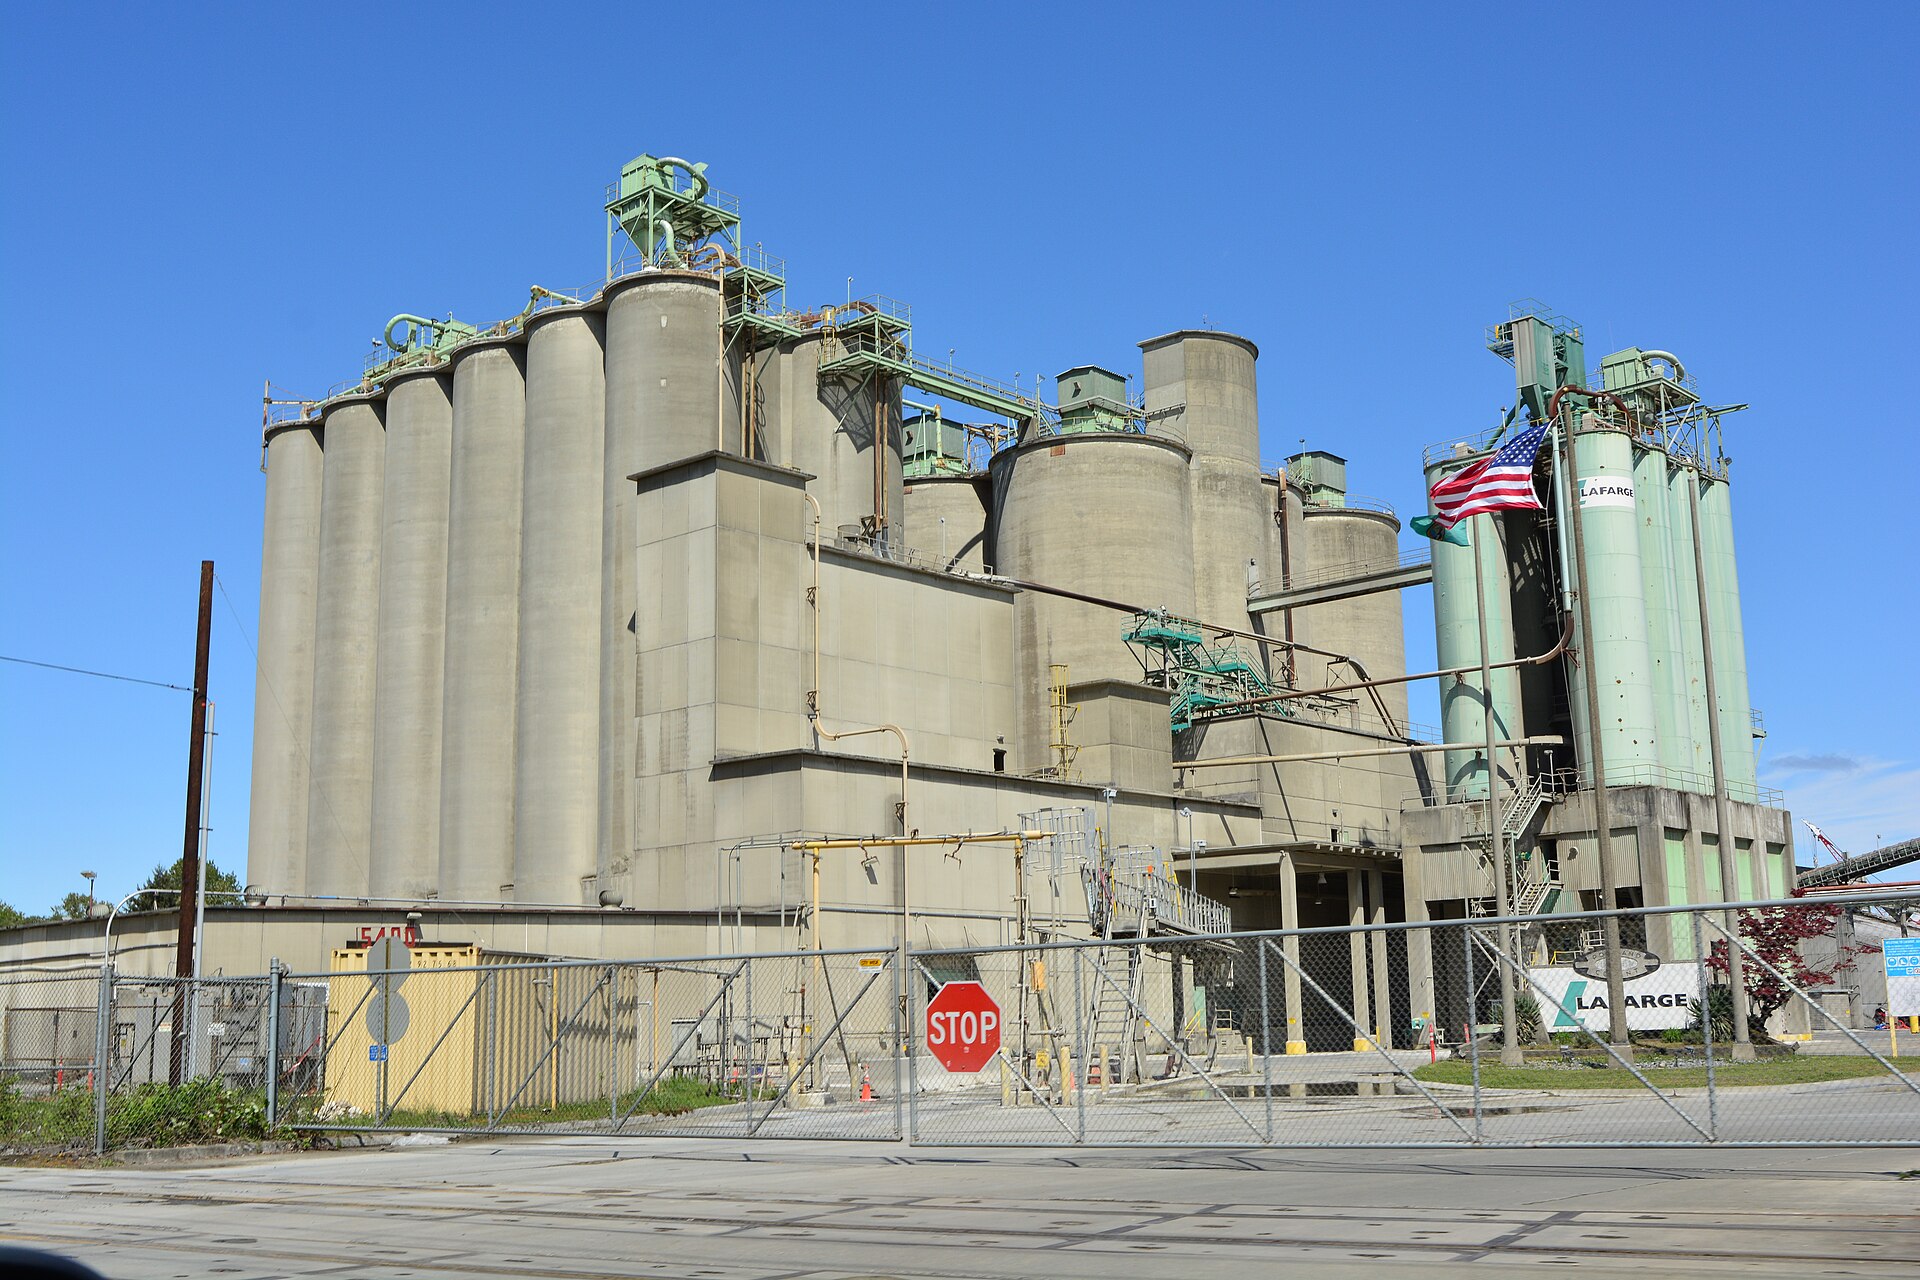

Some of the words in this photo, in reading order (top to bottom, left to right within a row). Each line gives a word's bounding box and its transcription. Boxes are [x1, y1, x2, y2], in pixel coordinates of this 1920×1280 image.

[1581, 487, 1634, 498] LAFARGE
[1593, 950, 1641, 959] POAND
[1576, 993, 1688, 1010] LAARGE
[930, 1010, 997, 1045] STOP
